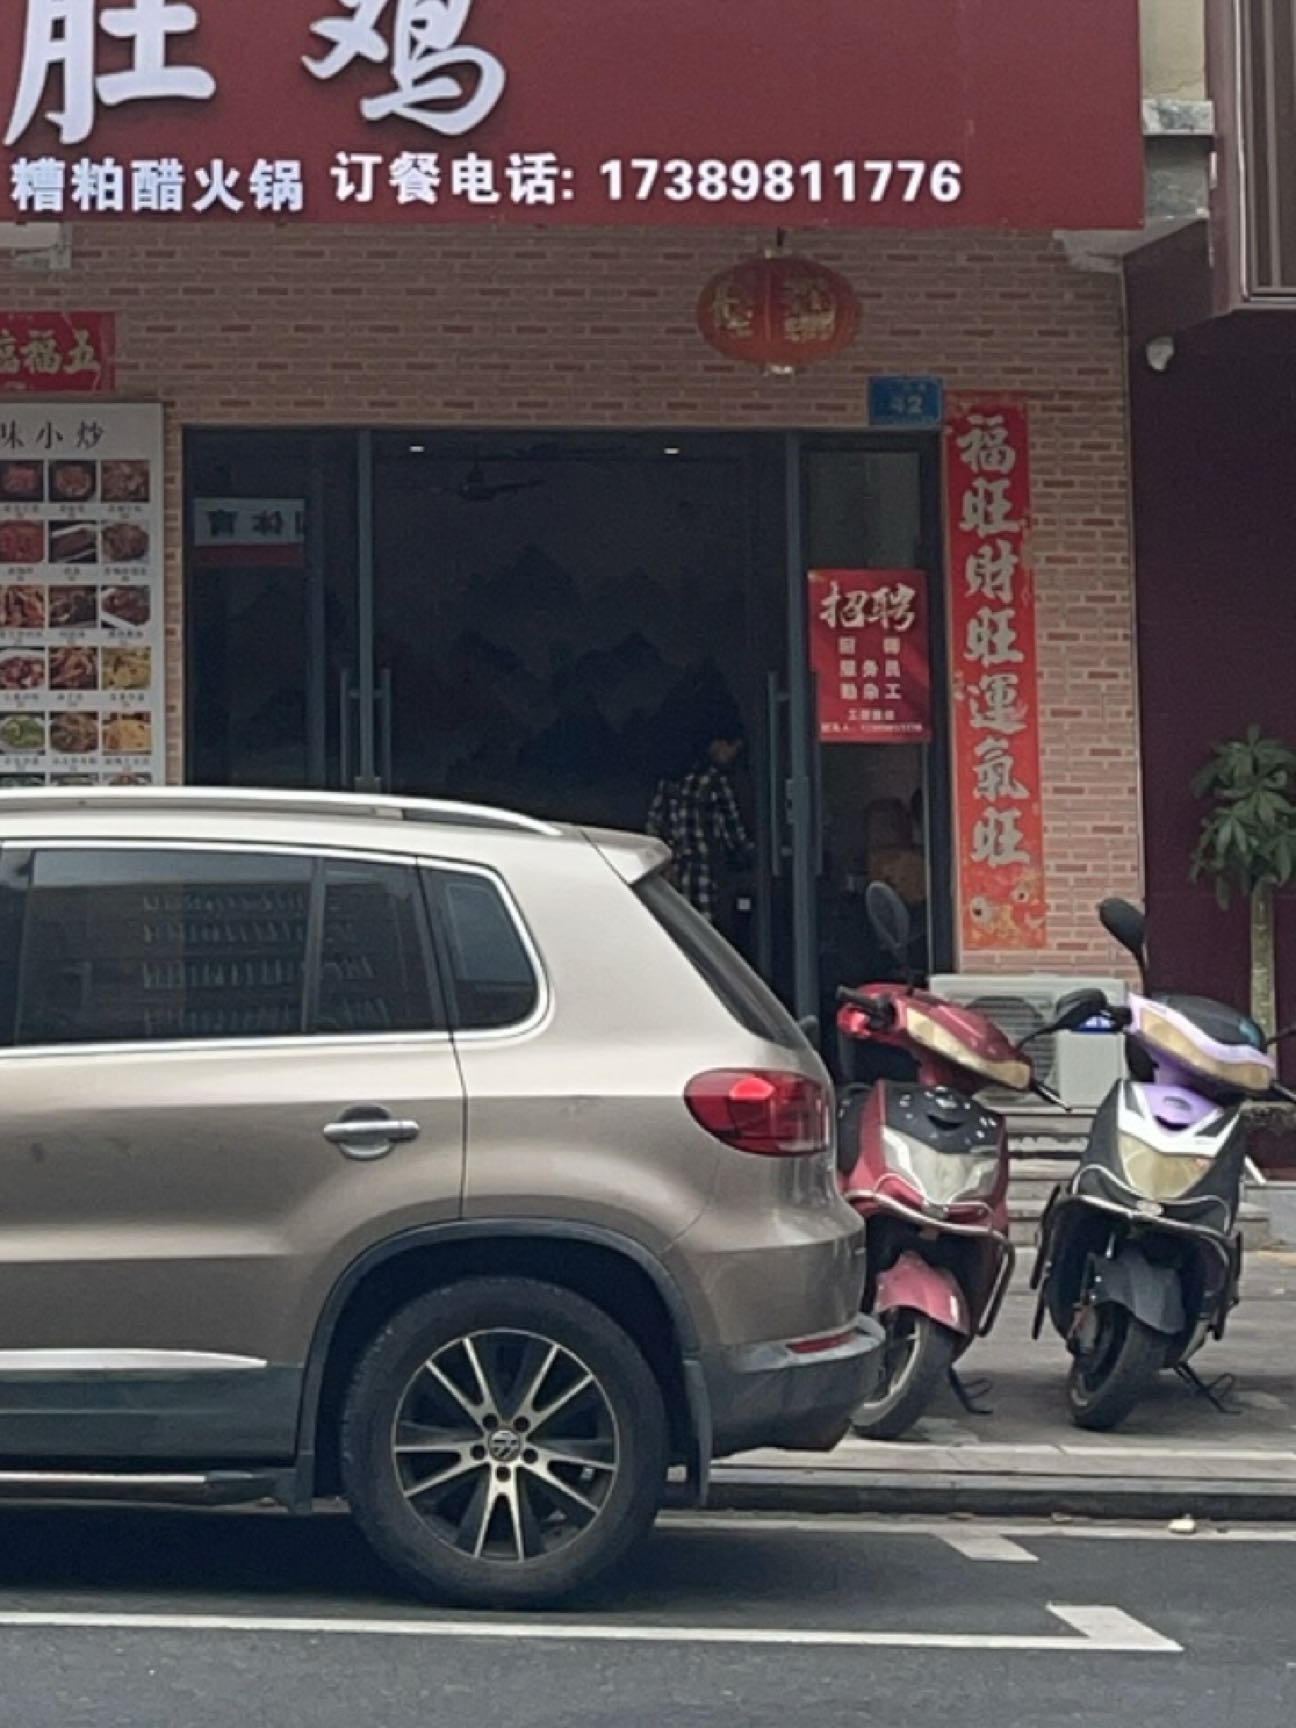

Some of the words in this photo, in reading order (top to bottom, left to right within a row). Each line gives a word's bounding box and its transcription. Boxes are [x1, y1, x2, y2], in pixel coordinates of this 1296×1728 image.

[11, 157, 304, 212] 糟粕醋火锅
[600, 158, 962, 203] 17389811776
[818, 581, 917, 633] 招聘
